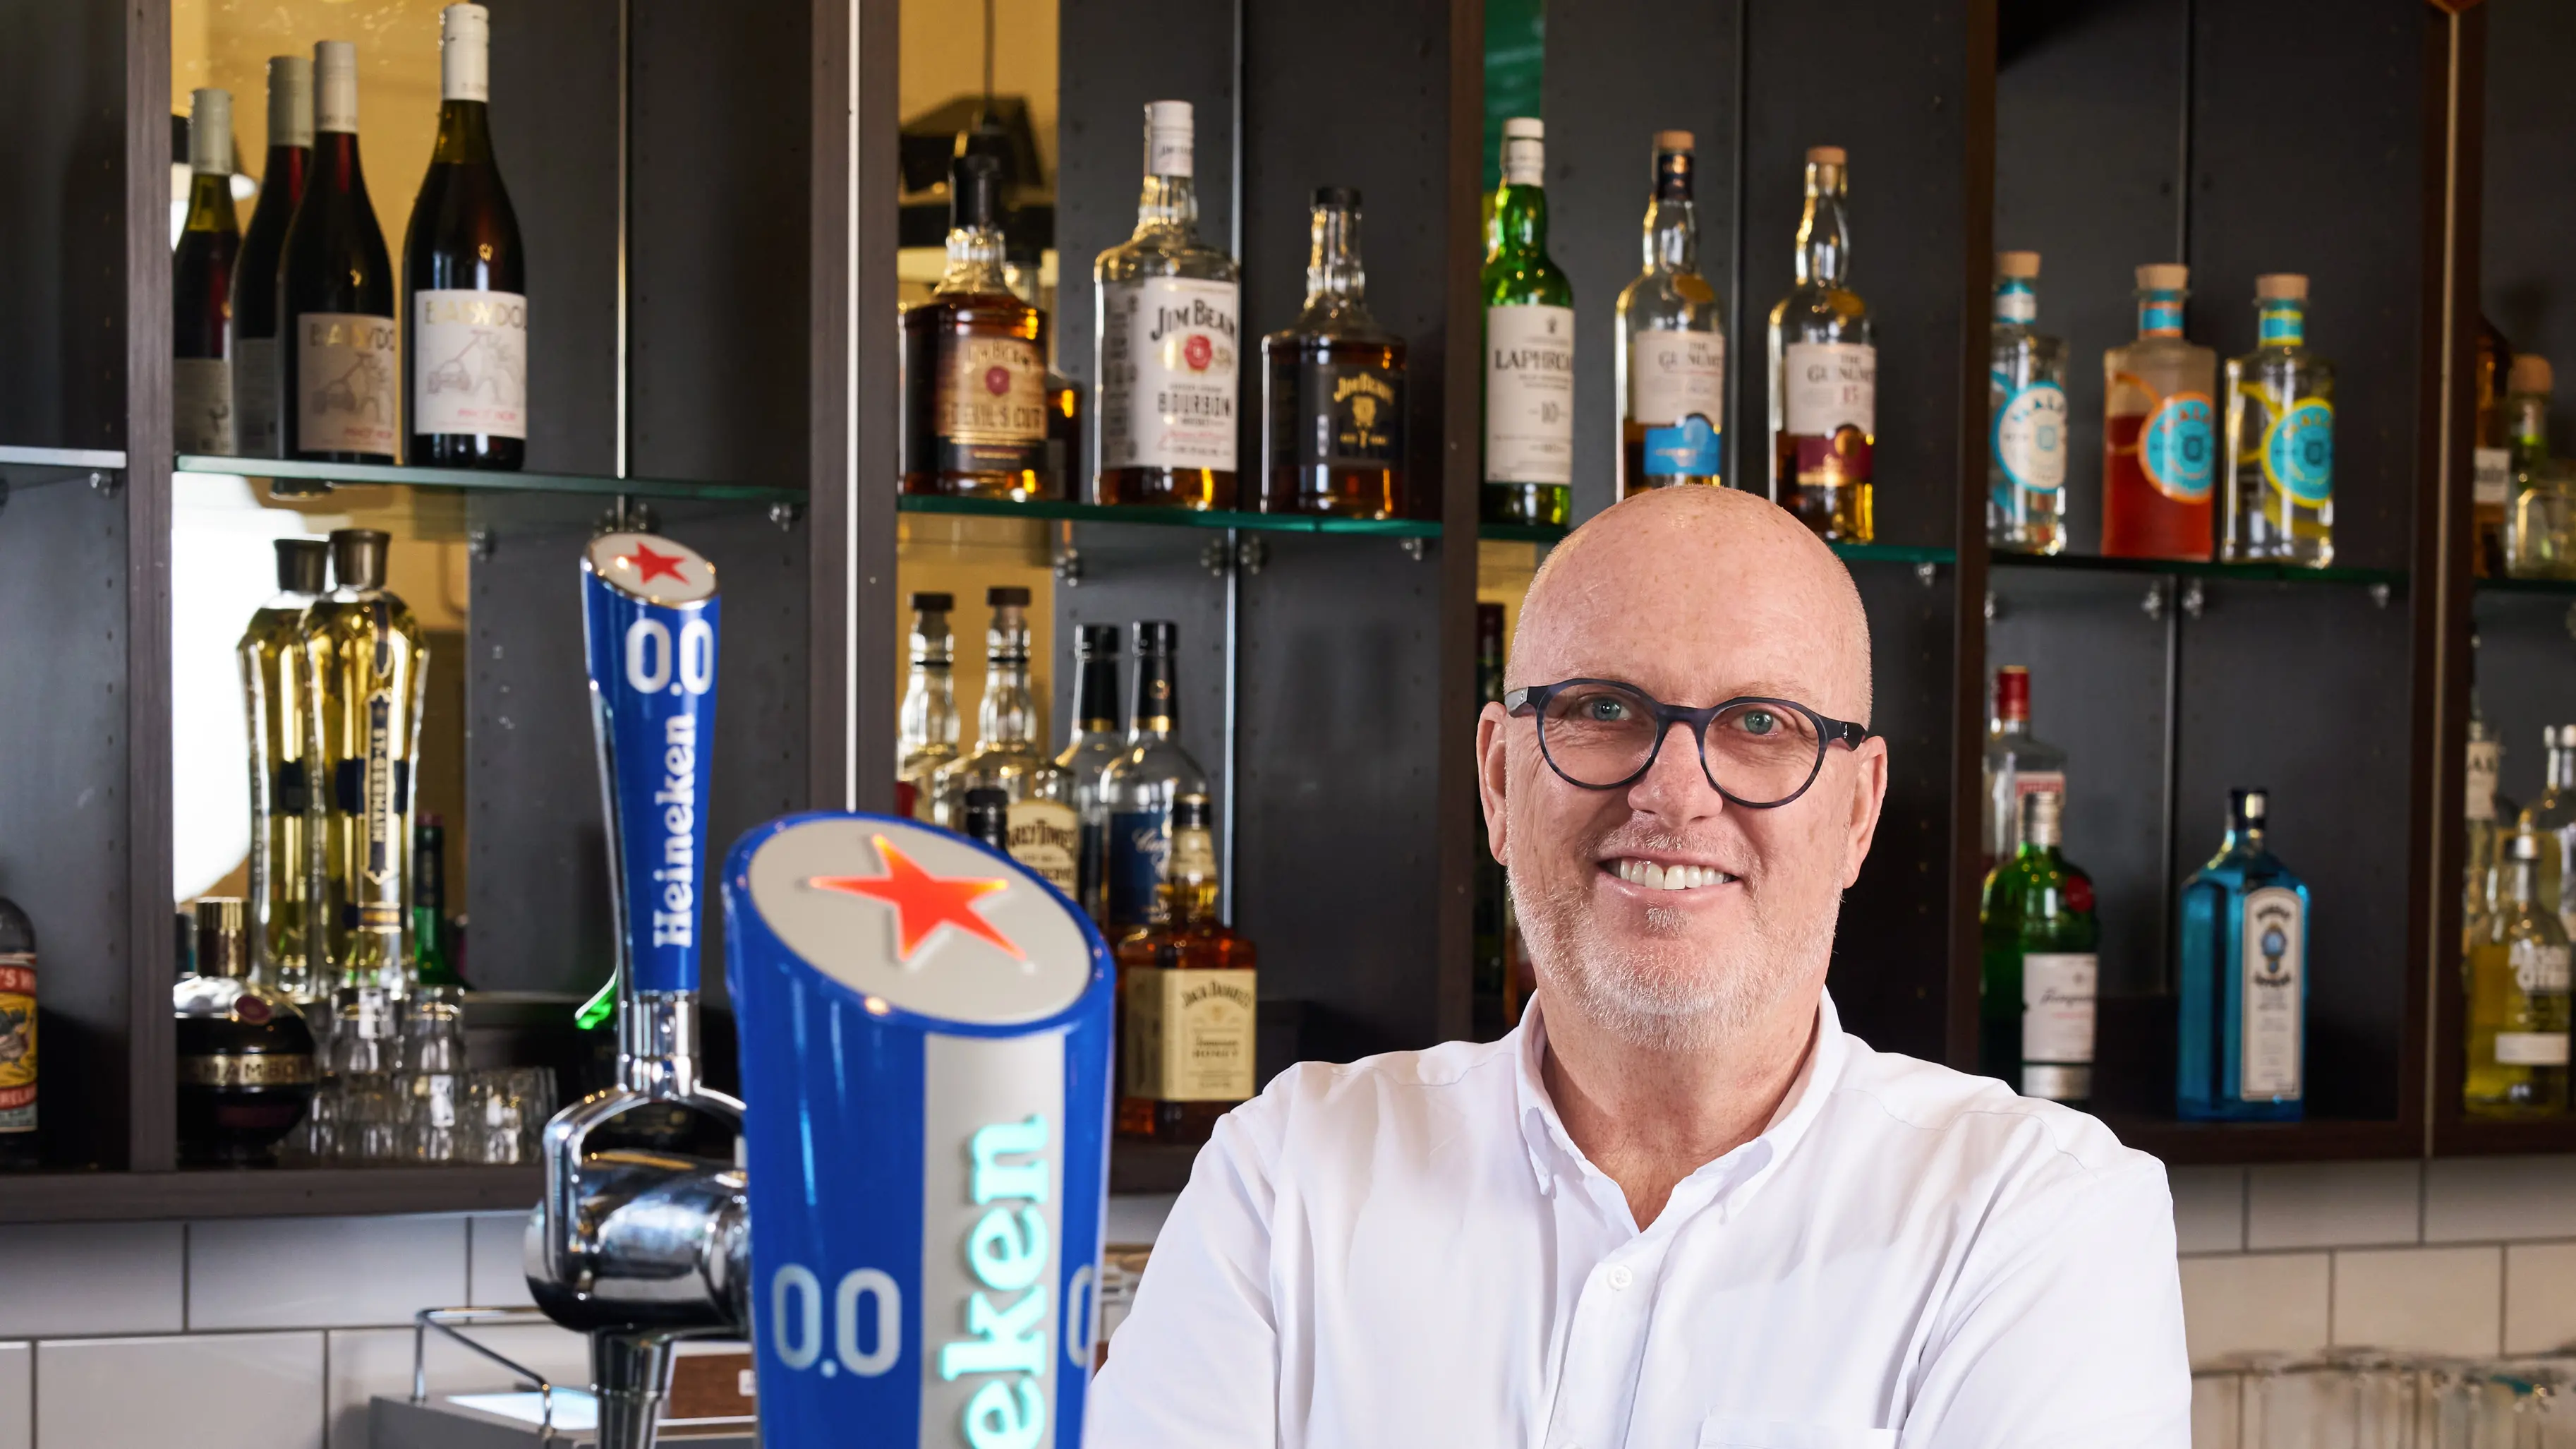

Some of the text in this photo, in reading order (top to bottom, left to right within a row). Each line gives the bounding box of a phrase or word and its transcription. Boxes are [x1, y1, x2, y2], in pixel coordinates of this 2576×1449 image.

[1151, 305, 1190, 342] JIM
[624, 618, 714, 697] 0.0
[653, 711, 697, 949] Heineken
[771, 1263, 902, 1377] 0.0
